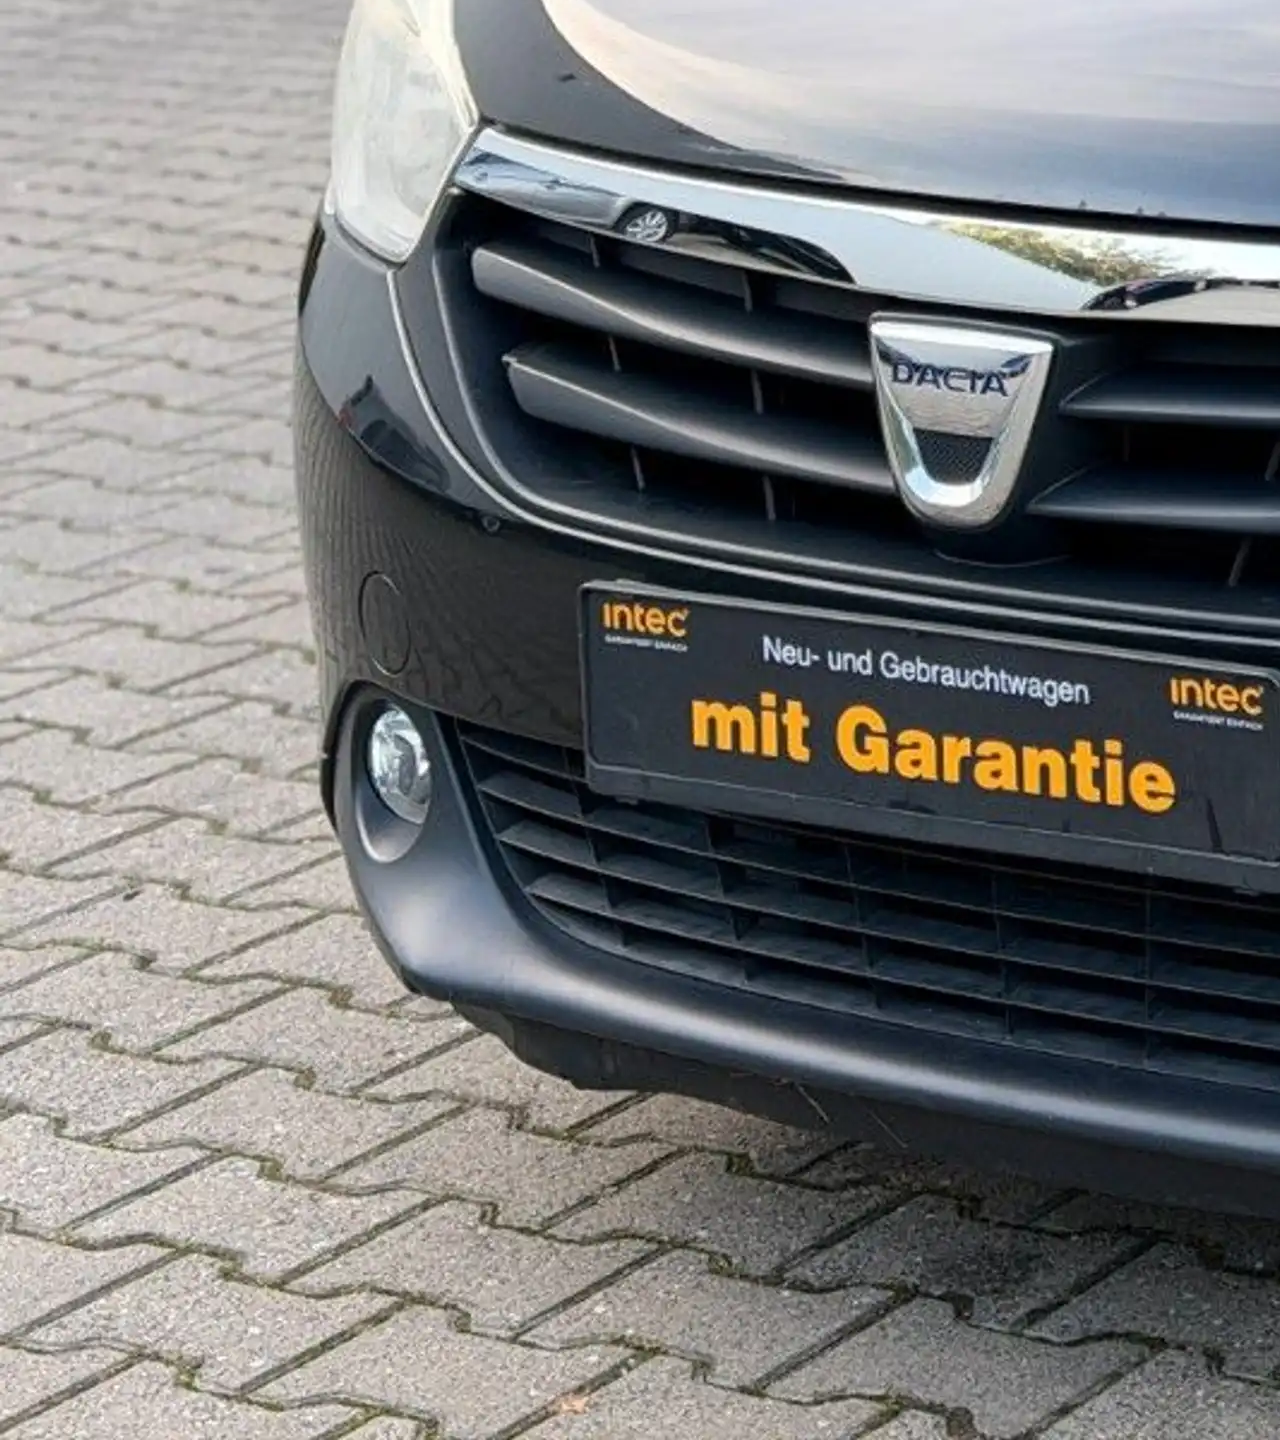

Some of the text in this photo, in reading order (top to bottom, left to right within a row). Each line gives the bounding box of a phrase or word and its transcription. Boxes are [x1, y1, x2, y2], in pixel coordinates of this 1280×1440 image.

[890, 361, 1009, 398] DACIA
[603, 603, 690, 637] intec
[762, 635, 1091, 707] Neu- und Gebrauchtwagen
[1170, 677, 1264, 716] intec
[691, 691, 1177, 814] mit Garantie
